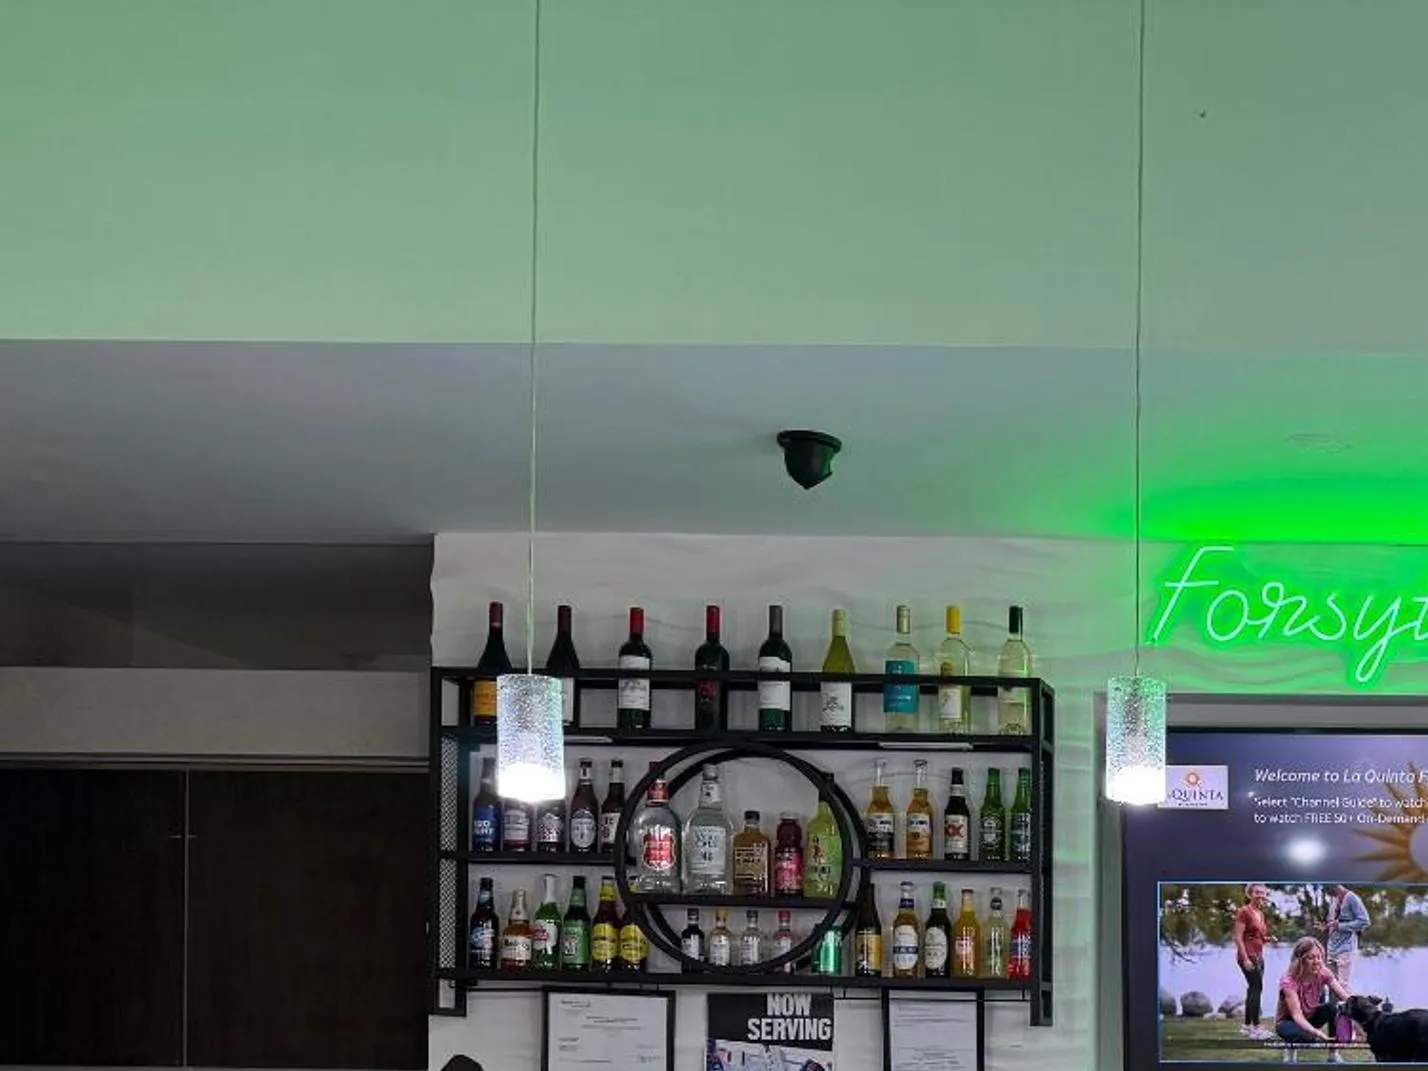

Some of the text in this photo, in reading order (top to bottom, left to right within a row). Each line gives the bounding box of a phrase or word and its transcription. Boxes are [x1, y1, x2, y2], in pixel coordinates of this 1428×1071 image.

[1254, 769, 1320, 783] Welcome
[1323, 770, 1338, 783] to
[1343, 769, 1361, 783] La
[1364, 769, 1415, 785] Quinta
[1254, 813, 1267, 823] to
[1305, 813, 1332, 823] FREE
[766, 993, 812, 1017] NOW
[747, 1018, 832, 1041] SERVING
